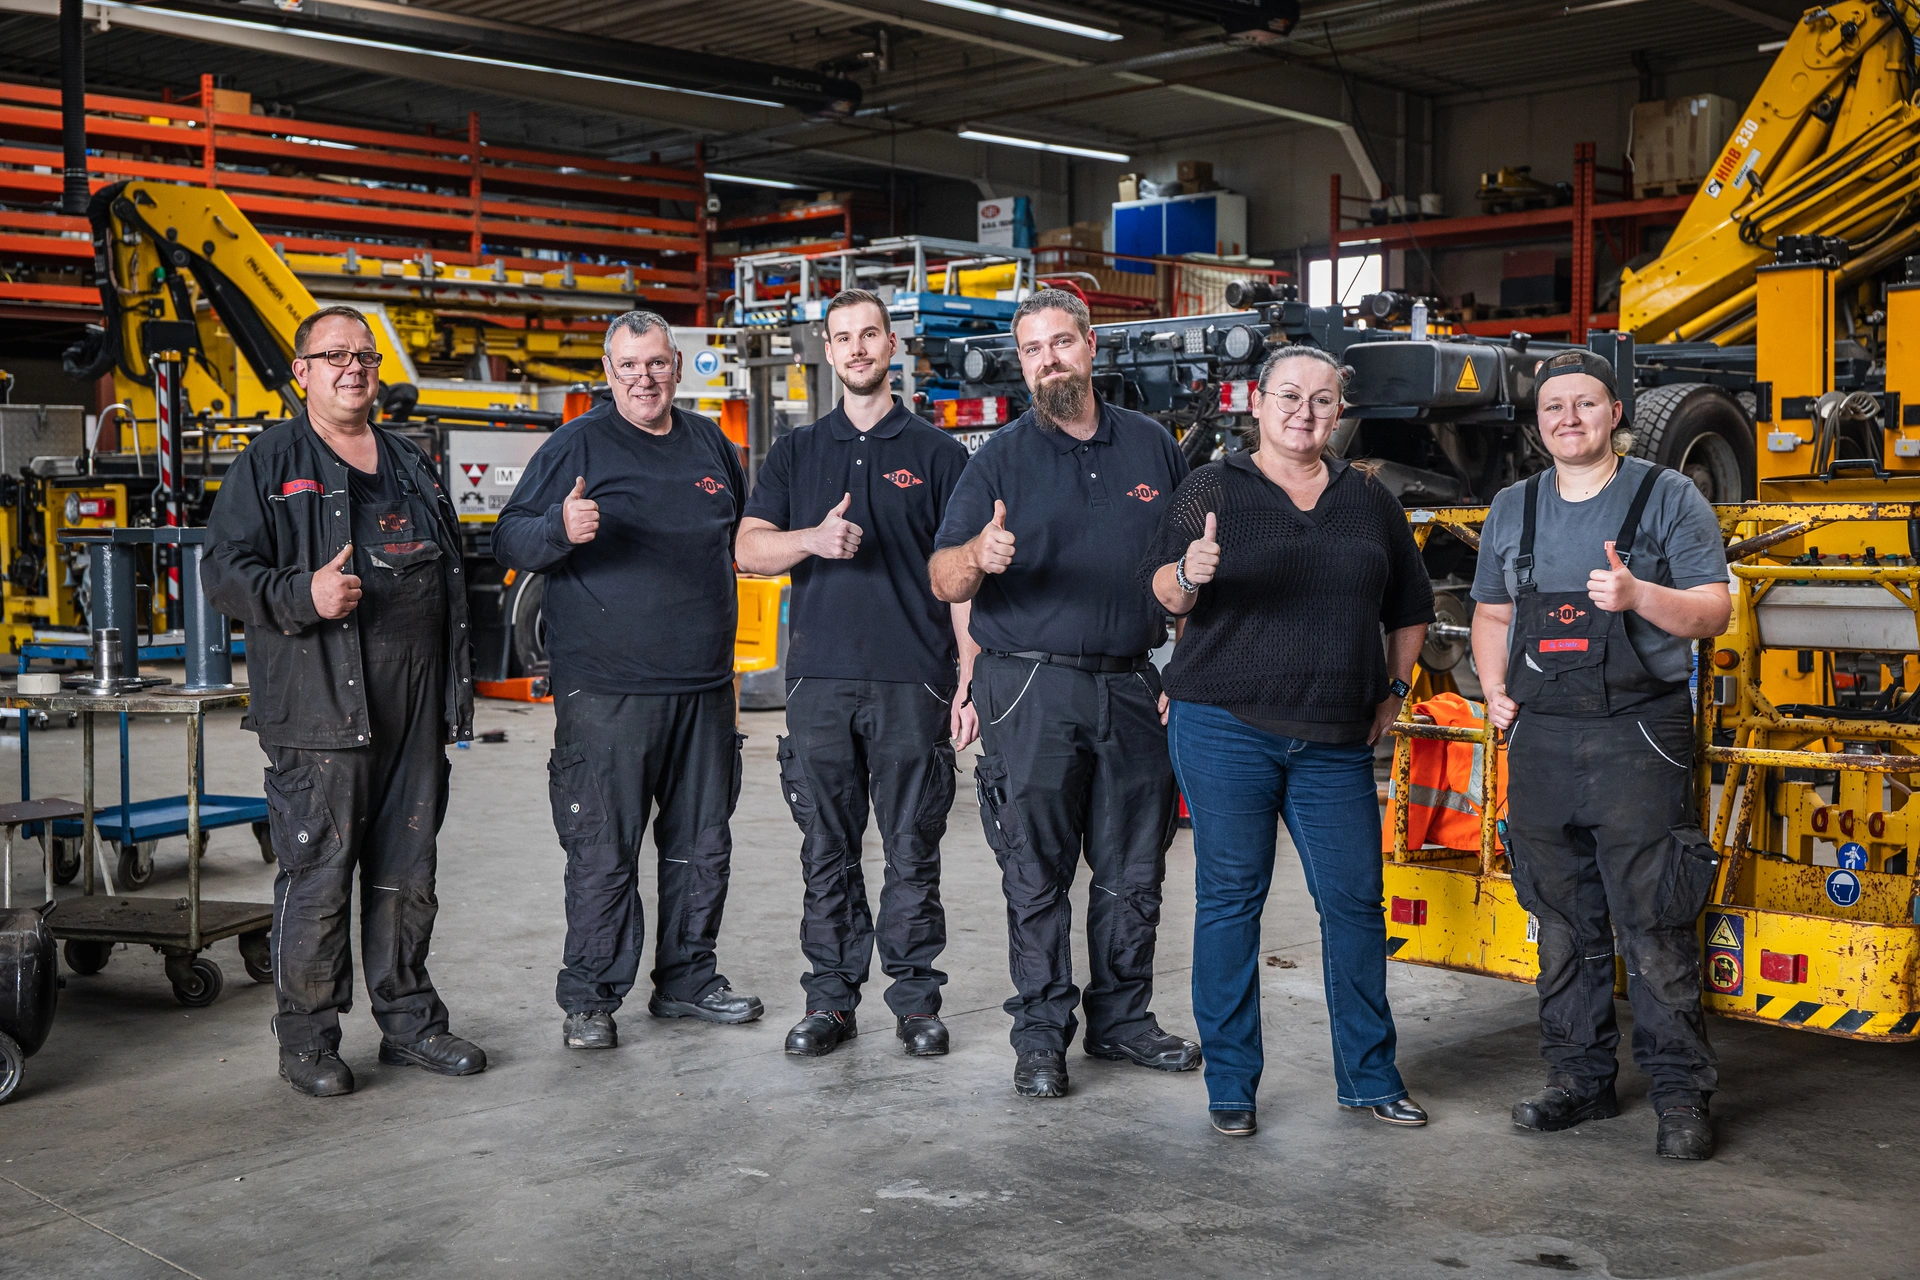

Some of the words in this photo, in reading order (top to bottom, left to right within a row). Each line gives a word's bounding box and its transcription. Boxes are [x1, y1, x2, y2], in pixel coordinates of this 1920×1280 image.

[1715, 147, 1742, 182] HIAB
[1735, 118, 1759, 148] 330
[246, 256, 284, 301] PALFINGER
[497, 470, 513, 481] IM
